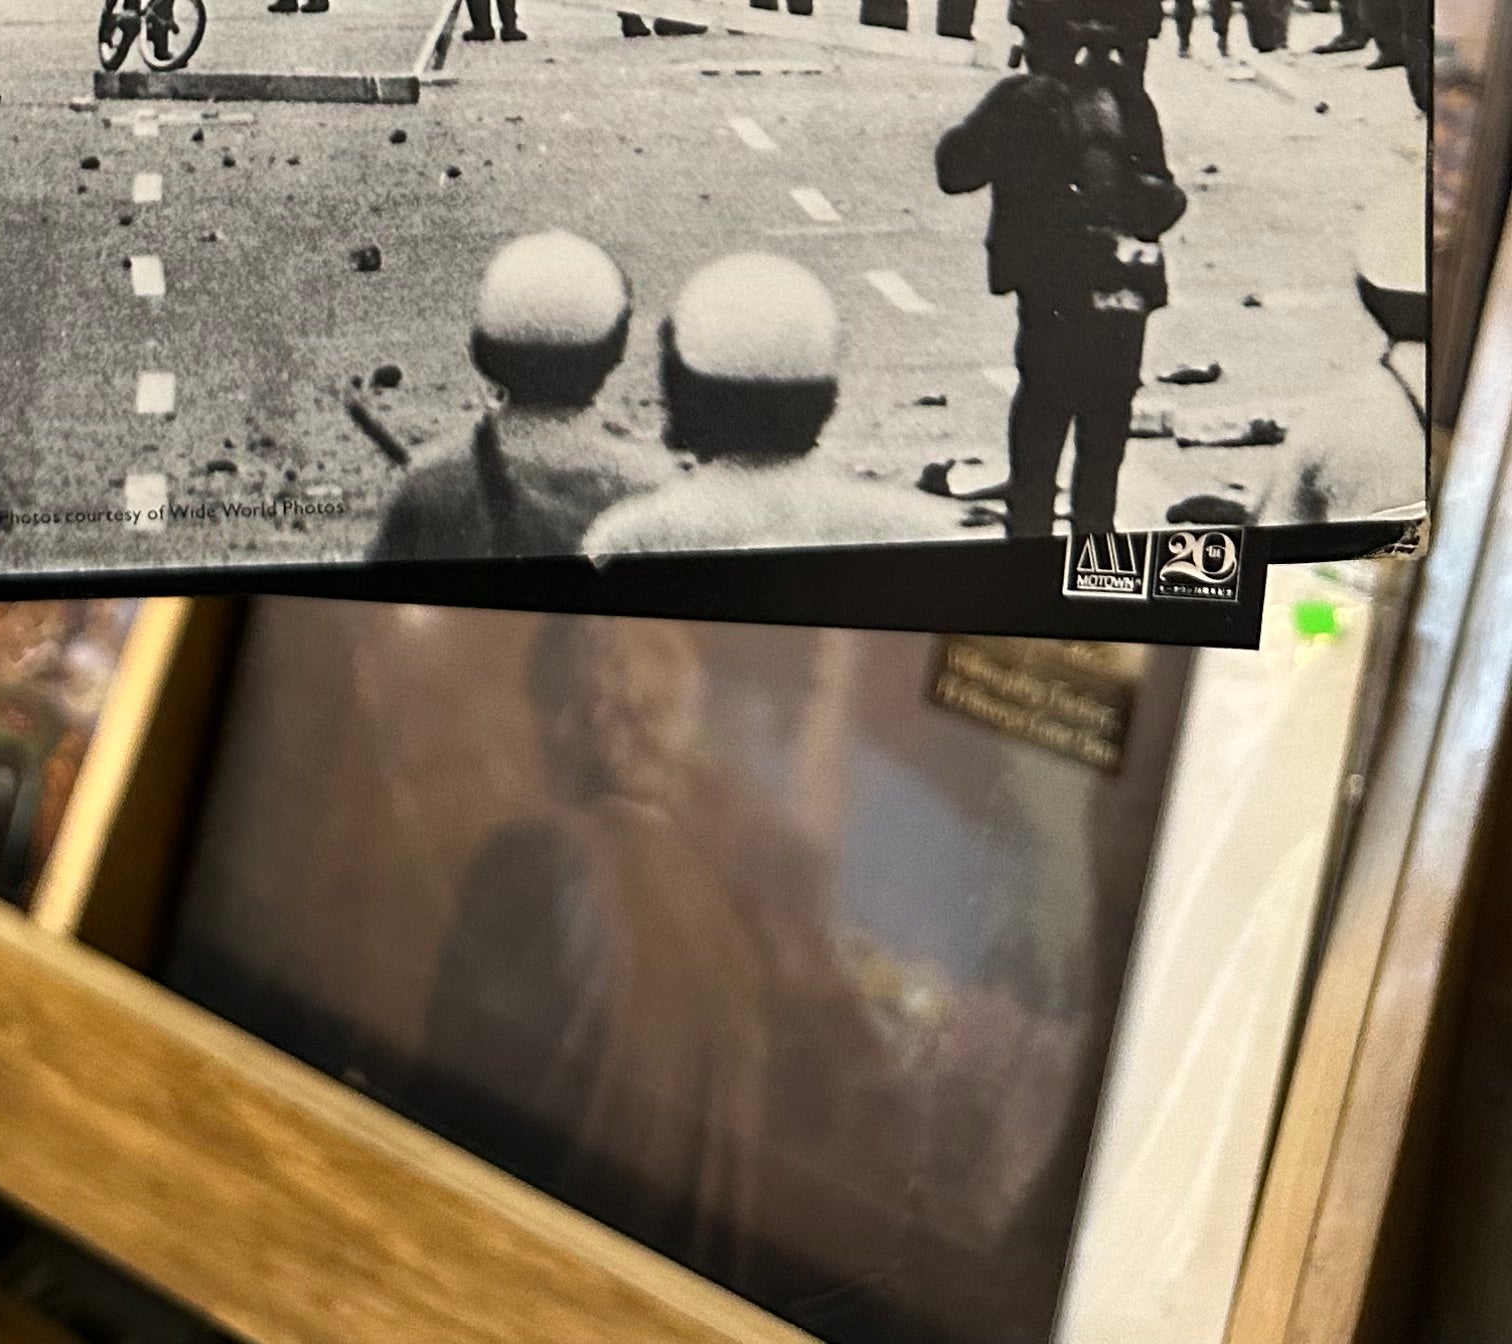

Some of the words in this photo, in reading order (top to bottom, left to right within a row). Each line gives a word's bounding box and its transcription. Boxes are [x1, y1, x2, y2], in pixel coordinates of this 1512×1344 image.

[0, 510, 61, 525] Photos
[65, 509, 141, 525] courtesy
[147, 504, 166, 520] of
[168, 502, 218, 520] Wide
[221, 500, 277, 518] World
[283, 499, 345, 516] Photos
[1076, 574, 1135, 589] MOTOWN
